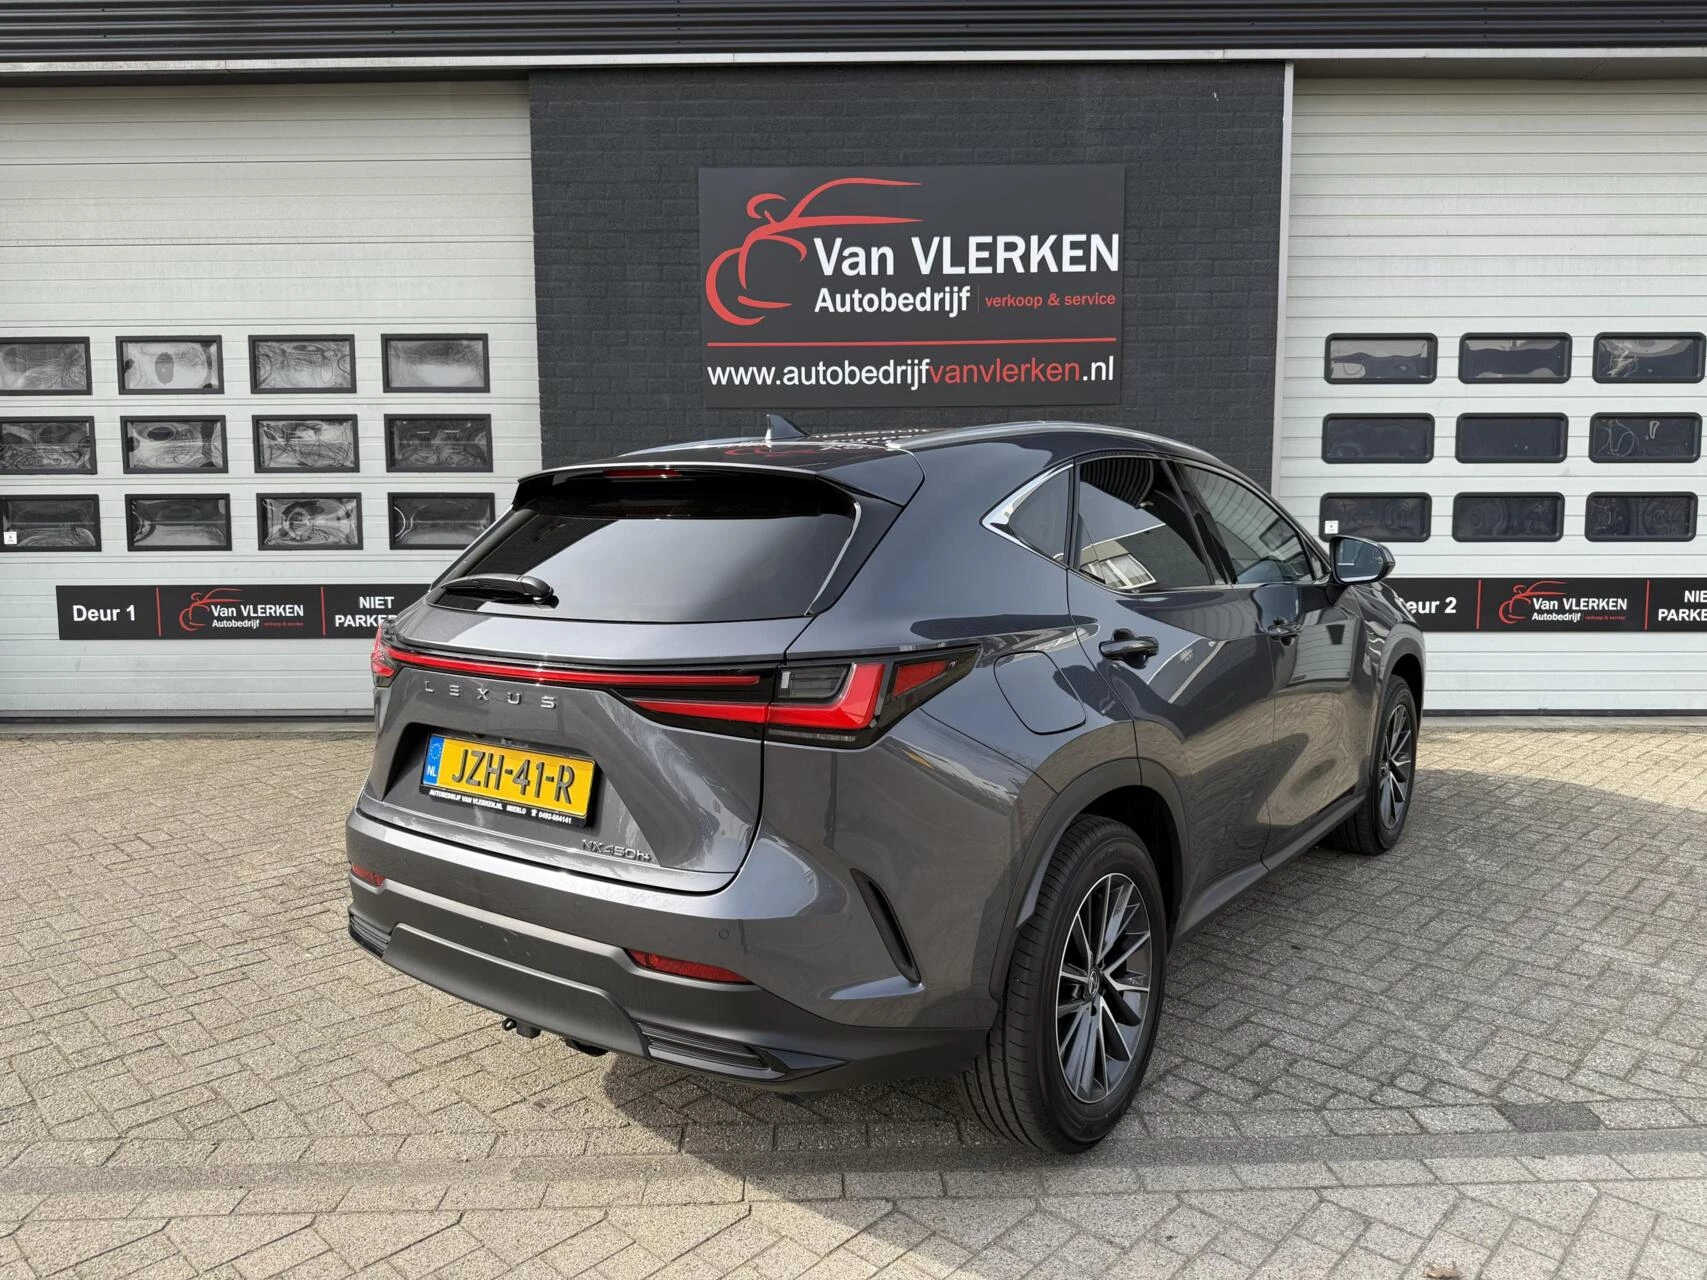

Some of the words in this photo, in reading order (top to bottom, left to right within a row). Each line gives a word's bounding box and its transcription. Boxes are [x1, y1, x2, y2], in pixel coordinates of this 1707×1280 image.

[814, 236, 895, 276] Van
[911, 233, 1120, 275] VLERKEN
[814, 286, 971, 317] Autobedrijf
[985, 294, 1043, 310] verkoop
[1047, 292, 1060, 307] &
[1064, 291, 1116, 306] service
[707, 355, 1115, 391] www.autobedrijfvanvlerken.nl
[211, 604, 237, 617] Van
[240, 604, 304, 617] VLERKEN
[359, 596, 395, 609] NIET
[1400, 598, 1440, 614] eur
[1444, 596, 1457, 614] 2
[1532, 597, 1558, 610] Van
[1563, 597, 1627, 611] VLERKEN
[72, 604, 121, 622] Deur
[126, 604, 135, 622] 1
[1531, 612, 1582, 623] Autobedrijf
[212, 619, 260, 629] Autobedrijf
[424, 680, 557, 709] LEXUS
[426, 765, 437, 778] NL
[452, 748, 576, 805] JZH-41-R
[582, 838, 652, 862] NX450h+
